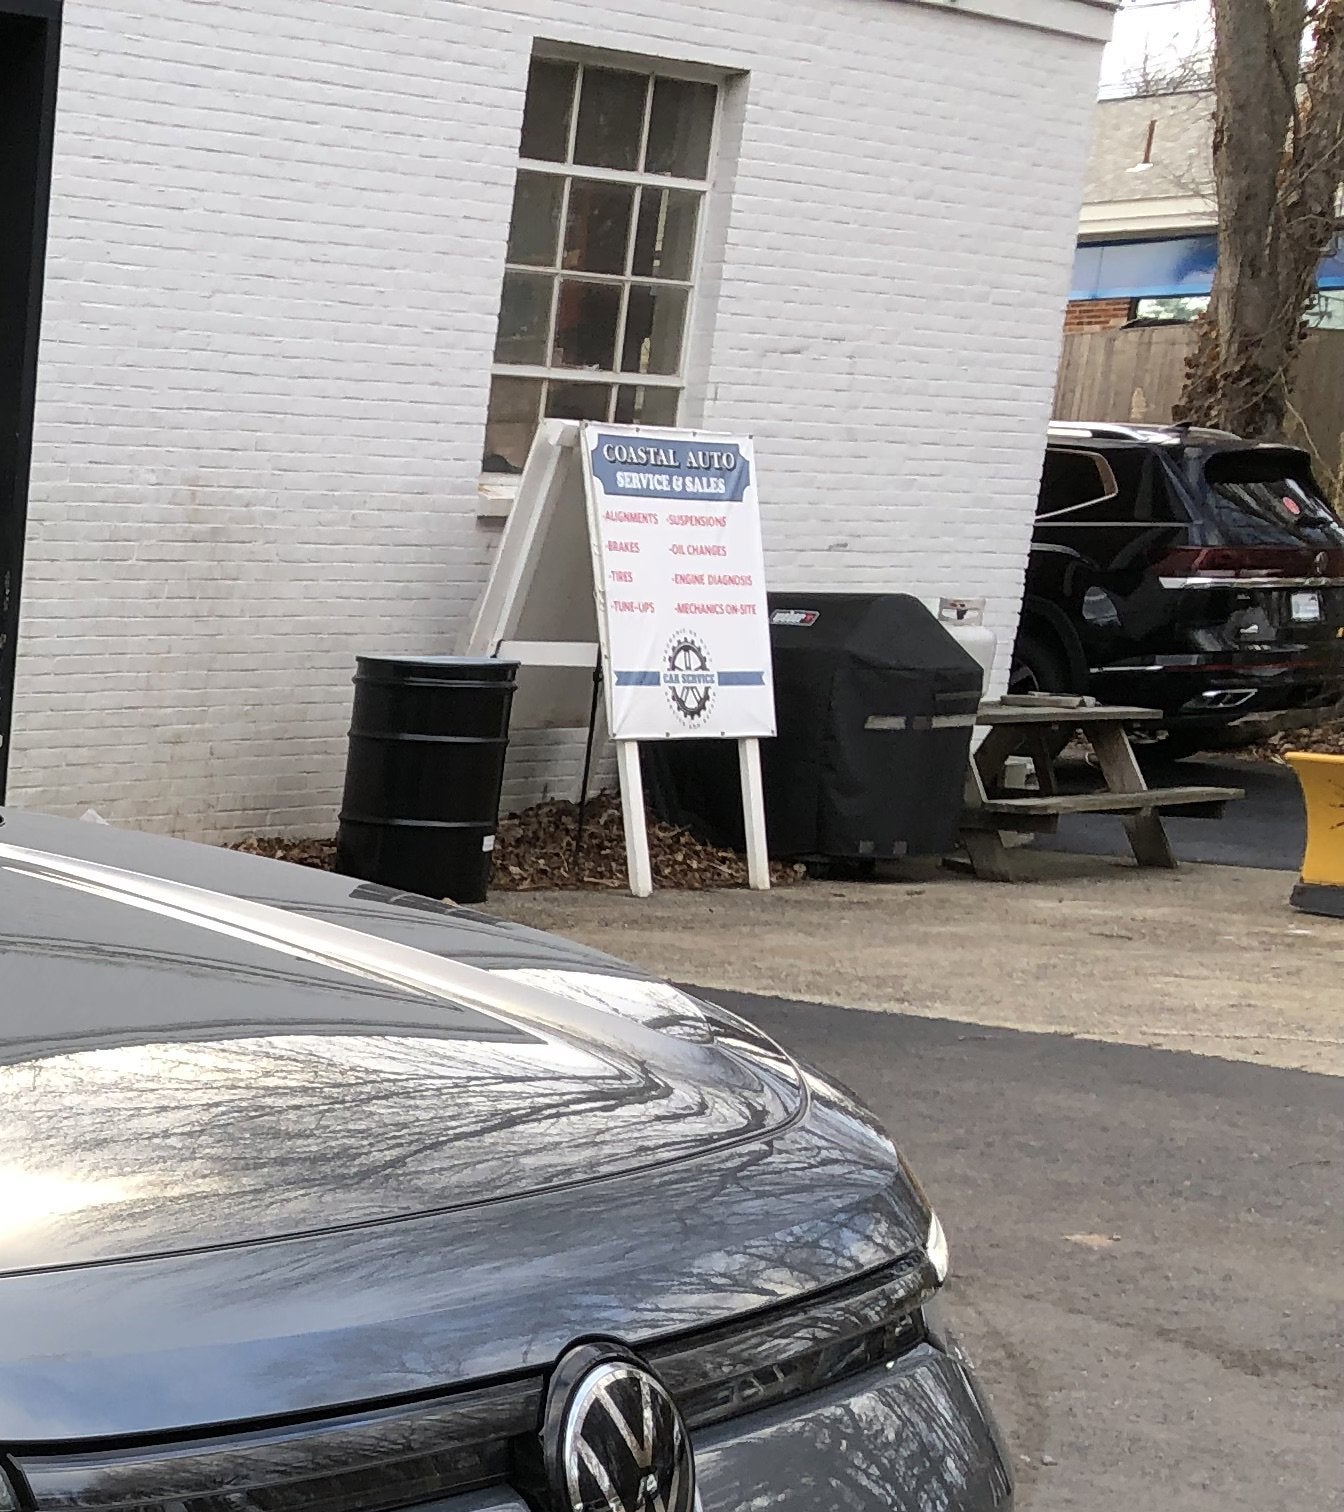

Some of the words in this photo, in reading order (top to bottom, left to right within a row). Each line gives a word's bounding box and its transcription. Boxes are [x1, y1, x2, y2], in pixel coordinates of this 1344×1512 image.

[603, 443, 680, 468] COASTAL
[686, 450, 737, 470] AUTO
[616, 471, 670, 491] SERVICE
[685, 477, 726, 493] SALES
[686, 544, 727, 557] CHANGES
[707, 574, 753, 586] DIAGNOSIS
[725, 603, 758, 615] ON-SITE
[663, 673, 680, 684] CAR
[681, 673, 715, 684] SERVICE
